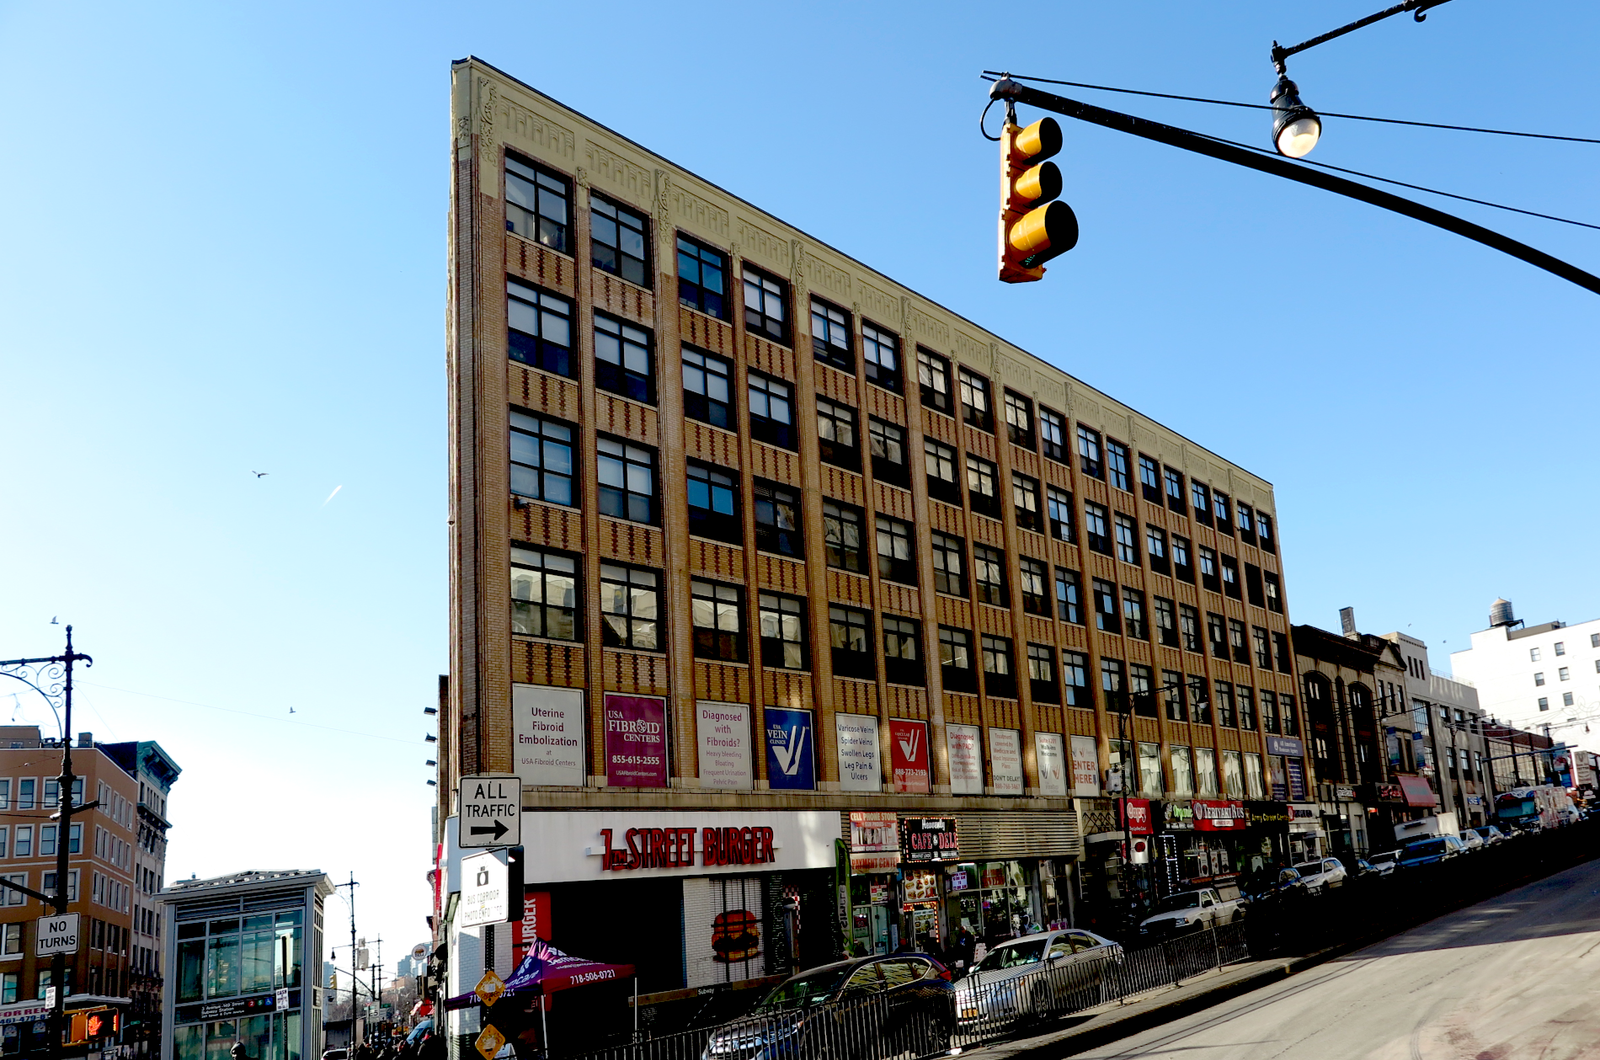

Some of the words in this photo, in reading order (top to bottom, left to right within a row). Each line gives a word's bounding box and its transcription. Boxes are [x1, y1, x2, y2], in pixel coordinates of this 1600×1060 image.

[531, 707, 565, 718] Uterine
[608, 710, 624, 719] USA
[702, 710, 742, 722] Diagnosed
[532, 721, 564, 732] Fibroid
[608, 718, 660, 734] FIBROID
[714, 724, 732, 734] with
[838, 724, 860, 733] Varicose
[860, 725, 875, 734] Veins
[623, 733, 661, 743] CENTERS
[766, 729, 788, 740] VEIN
[518, 734, 578, 746] Embolization
[706, 737, 741, 747] Fibroids?
[841, 737, 859, 746] Spider
[859, 738, 873, 746] Veins
[841, 749, 862, 757] Swollen
[862, 750, 875, 759] Legs
[534, 758, 554, 766] Fibroid
[612, 755, 660, 765] 855-615-2555
[715, 760, 735, 768] Bloating
[844, 761, 855, 771] Leg
[856, 761, 868, 770] Pain
[867, 762, 873, 770] &
[1073, 760, 1096, 771] ENTER
[703, 769, 725, 777] Frequent
[725, 769, 747, 777] Urination
[850, 772, 869, 781] Ulcers
[1074, 774, 1092, 784] HERE
[474, 783, 508, 799] ALL
[465, 803, 515, 818] TRAFFIC
[850, 812, 863, 821] CELL
[863, 812, 881, 821] PHONE
[881, 812, 897, 821] STORE
[911, 832, 933, 850] CAFE
[938, 832, 958, 849] DELI
[626, 827, 697, 870] STREET
[702, 826, 775, 866] BURGER
[851, 857, 878, 870] PAYMENT
[49, 921, 67, 933] NO
[39, 935, 76, 949] TURNS
[569, 969, 616, 985] 718-506-0721
[24, 1007, 51, 1015] REN
